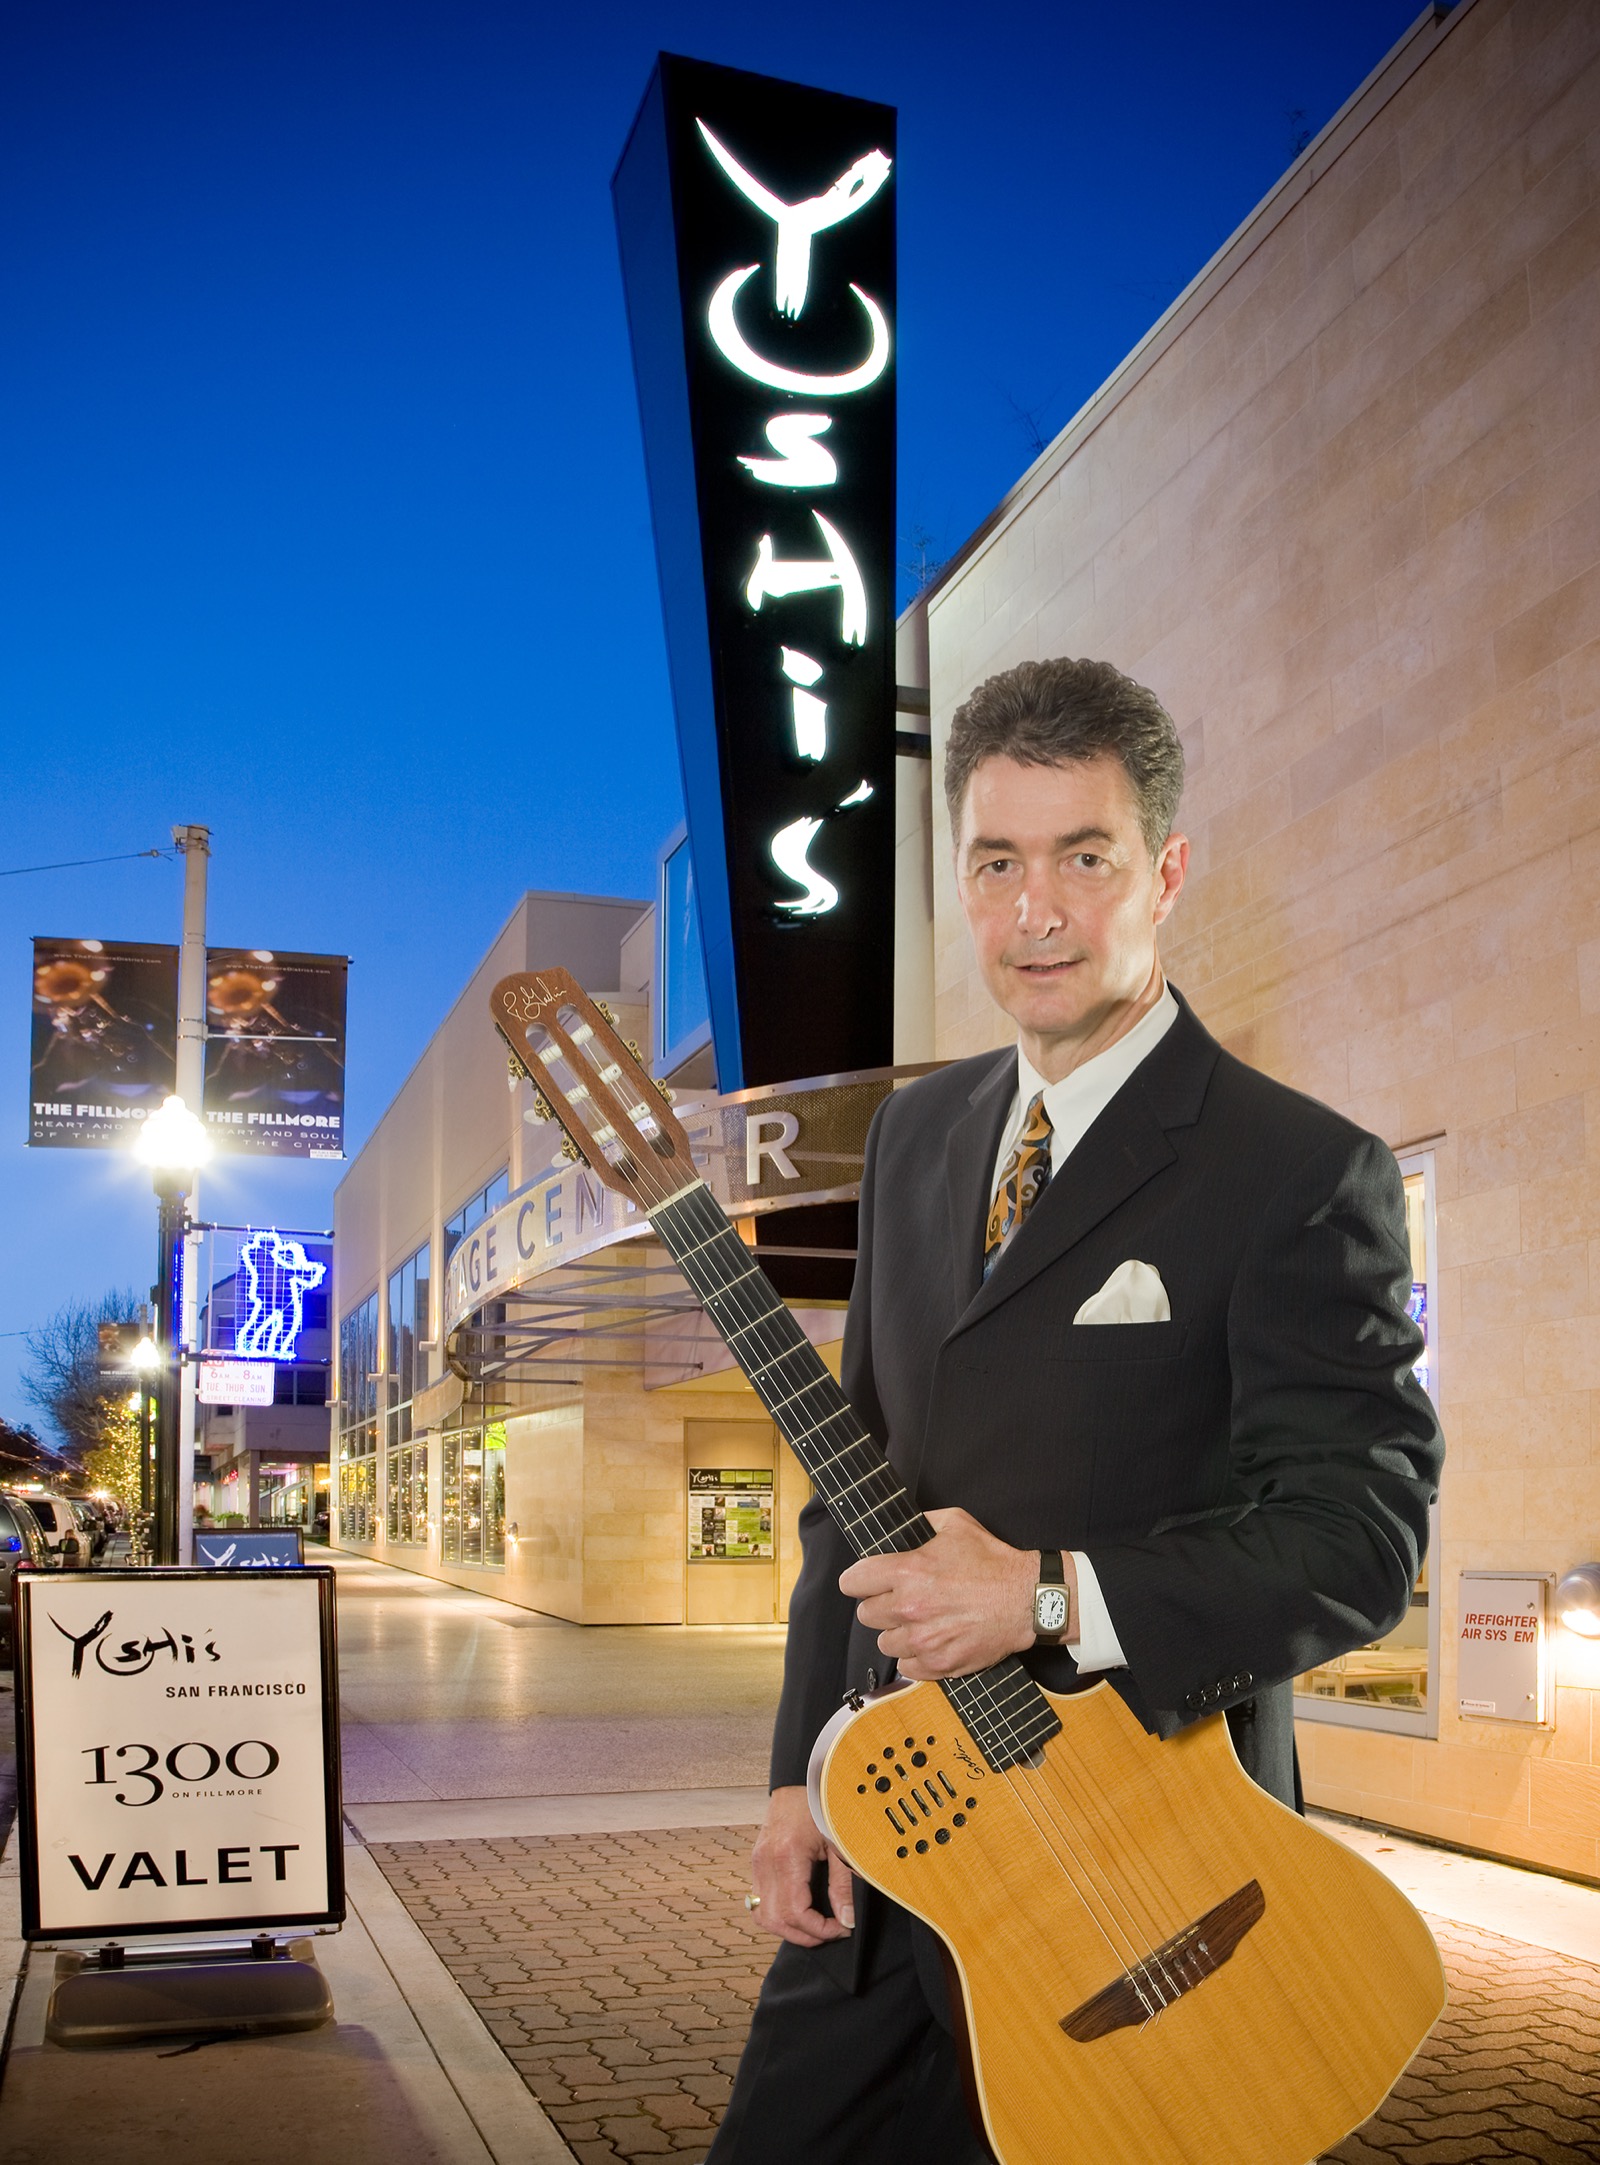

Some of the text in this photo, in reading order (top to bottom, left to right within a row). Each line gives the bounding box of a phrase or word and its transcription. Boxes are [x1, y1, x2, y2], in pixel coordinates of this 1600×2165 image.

[33, 1102, 152, 1119] THE FILLMO
[206, 1111, 340, 1128] THE FILLMORE
[72, 1132, 109, 1140] THE
[262, 1130, 293, 1138] AND
[300, 1132, 340, 1140] SOUL
[243, 1139, 279, 1147] THE
[516, 1110, 801, 1260] CENR
[1465, 1613, 1538, 1628] IREFIGHTER
[1461, 1627, 1482, 1639] AIR
[166, 1683, 306, 1698] SAN FRANCISCO
[81, 1740, 280, 1807] 1300
[172, 1788, 263, 1799] ON FILLMORE
[67, 1844, 300, 1891] VALET
